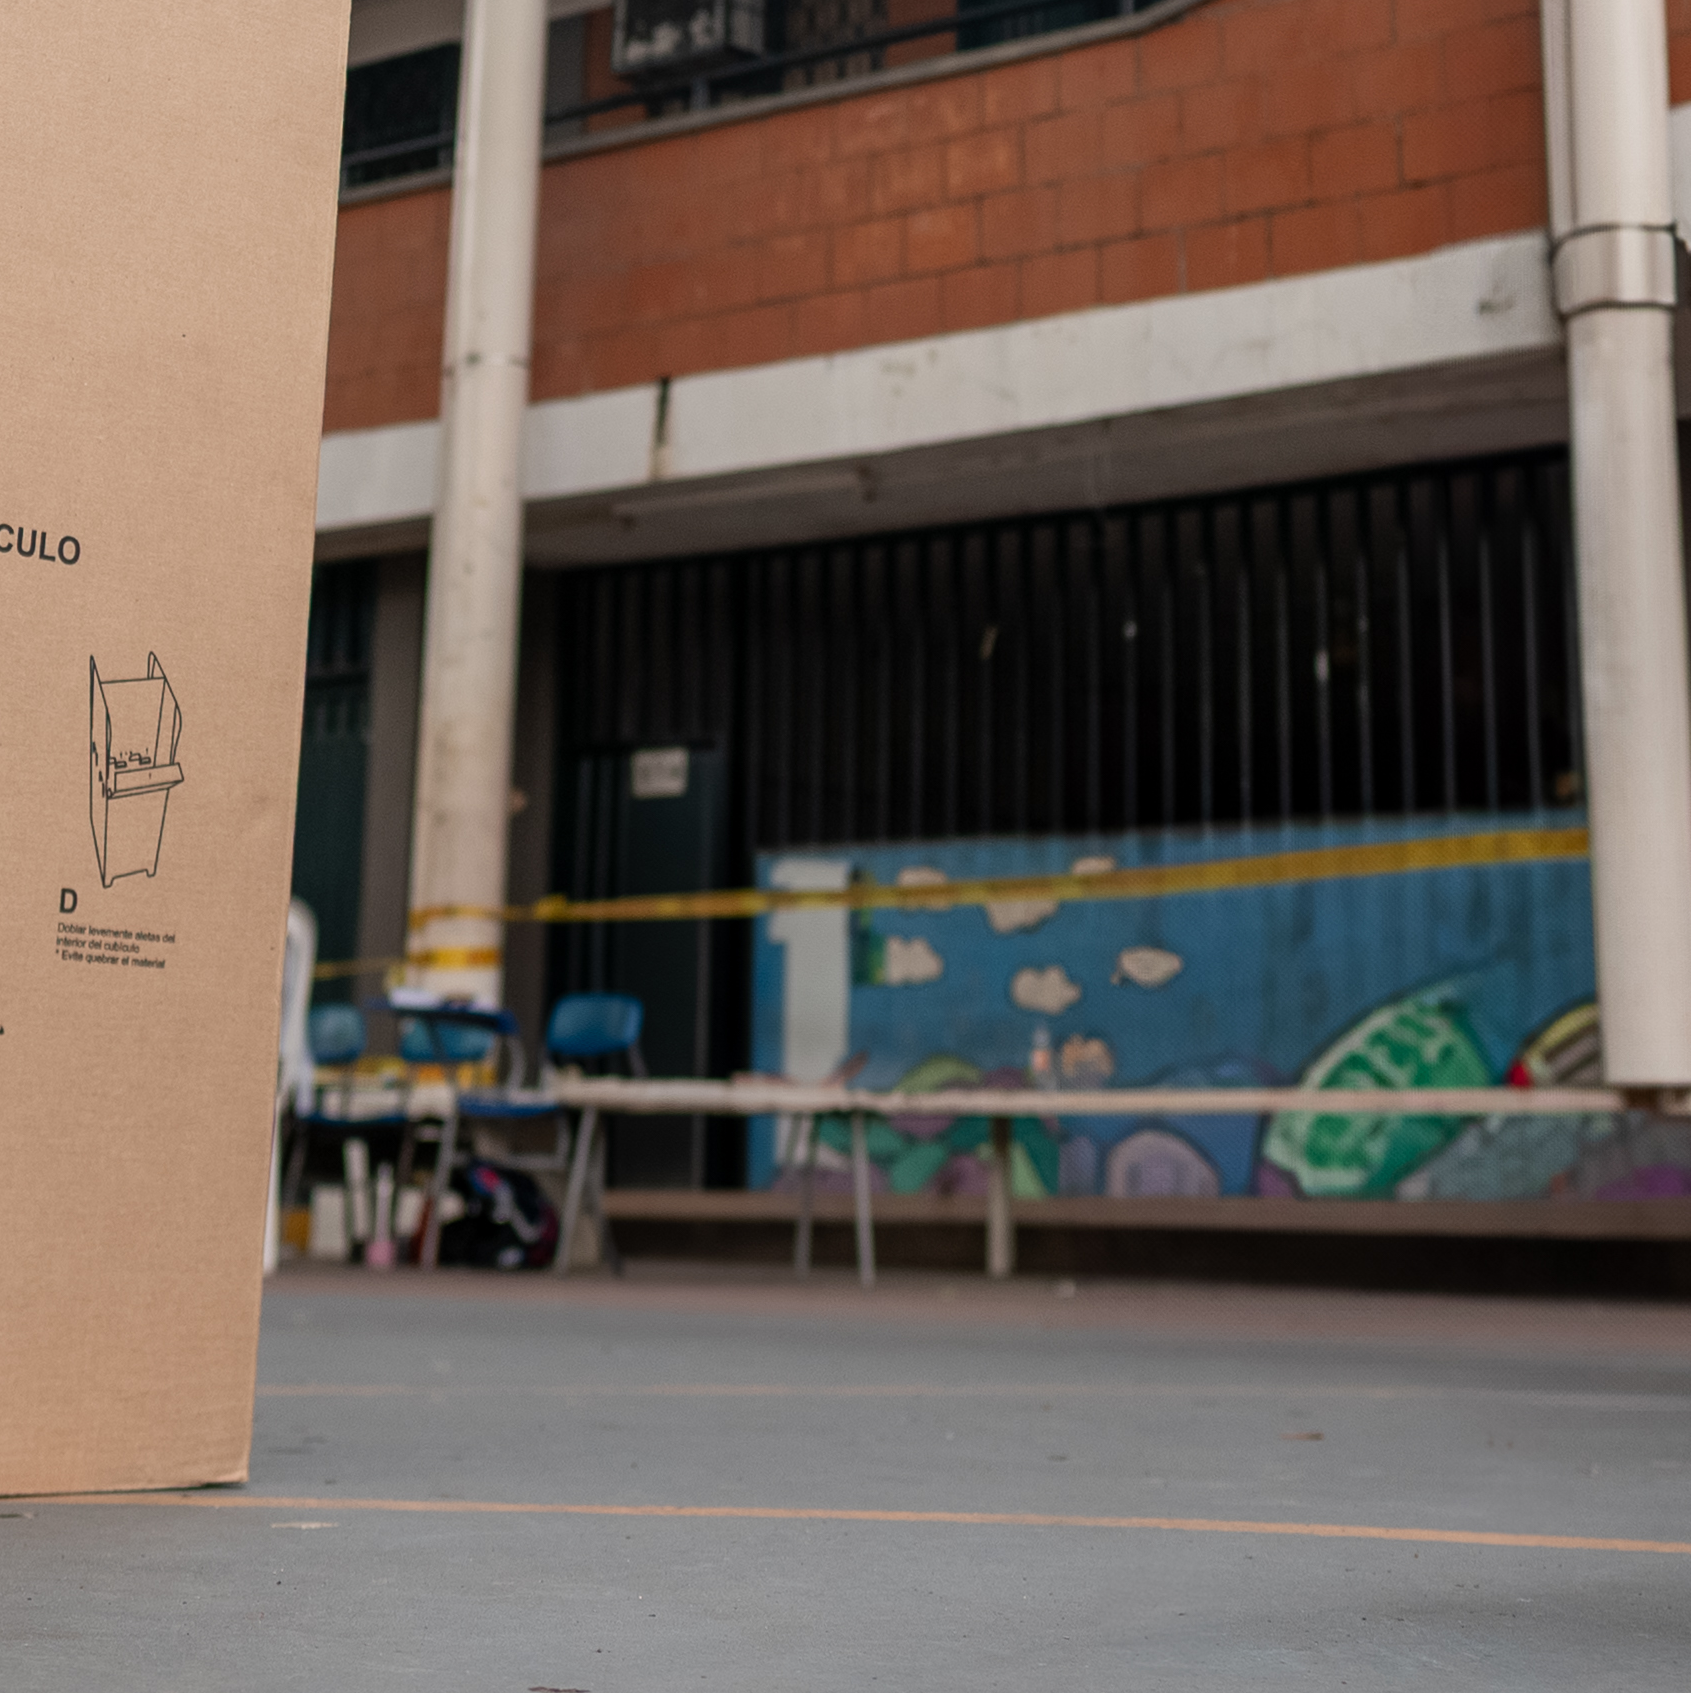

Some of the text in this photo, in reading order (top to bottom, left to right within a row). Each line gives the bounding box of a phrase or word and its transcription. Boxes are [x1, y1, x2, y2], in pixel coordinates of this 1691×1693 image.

[59, 888, 78, 913] D
[58, 922, 86, 934] Doblar
[135, 931, 160, 942] aletas
[162, 934, 175, 944] del
[88, 939, 102, 950] del
[121, 956, 129, 966] el
